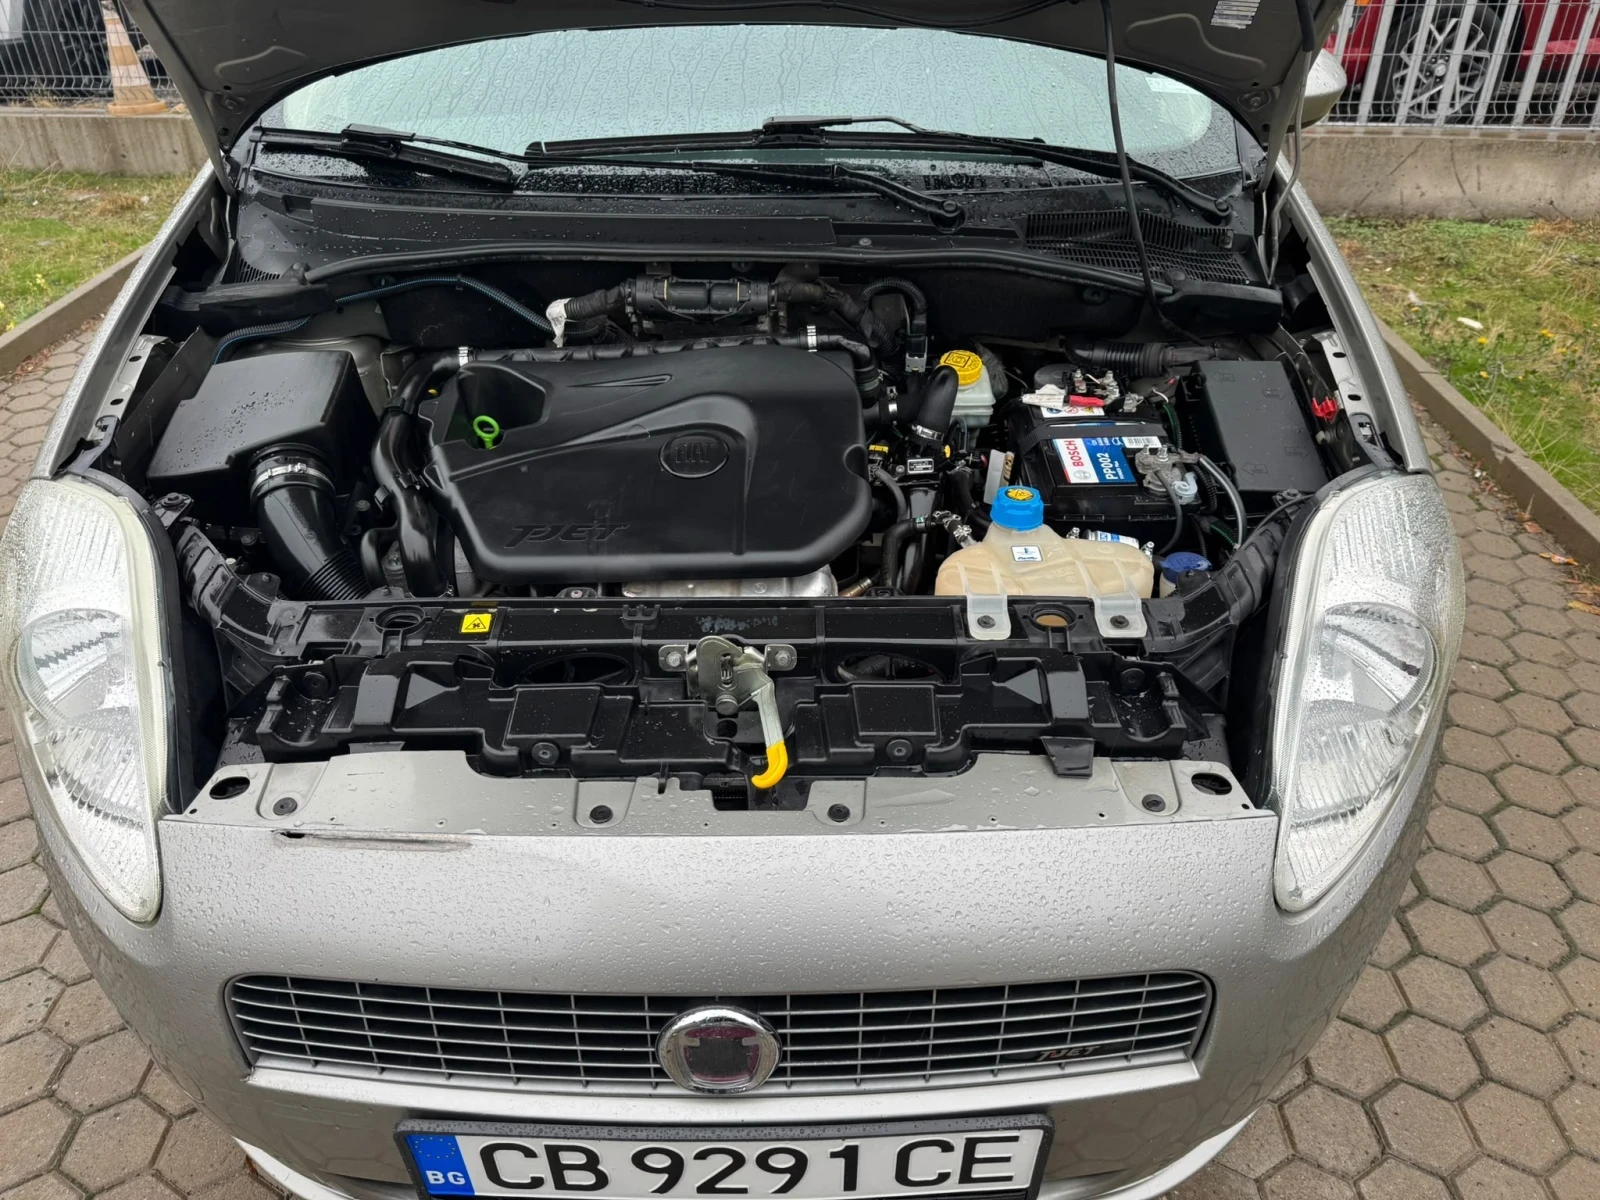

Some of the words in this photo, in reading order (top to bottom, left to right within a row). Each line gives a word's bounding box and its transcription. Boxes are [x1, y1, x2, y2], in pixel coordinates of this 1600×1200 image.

[1064, 440, 1085, 467] BOSCH
[1096, 452, 1118, 480] PP002
[425, 1170, 466, 1185] BG
[479, 1142, 609, 1192] CB
[631, 1144, 859, 1194] 9291
[895, 1135, 1020, 1187] CE
